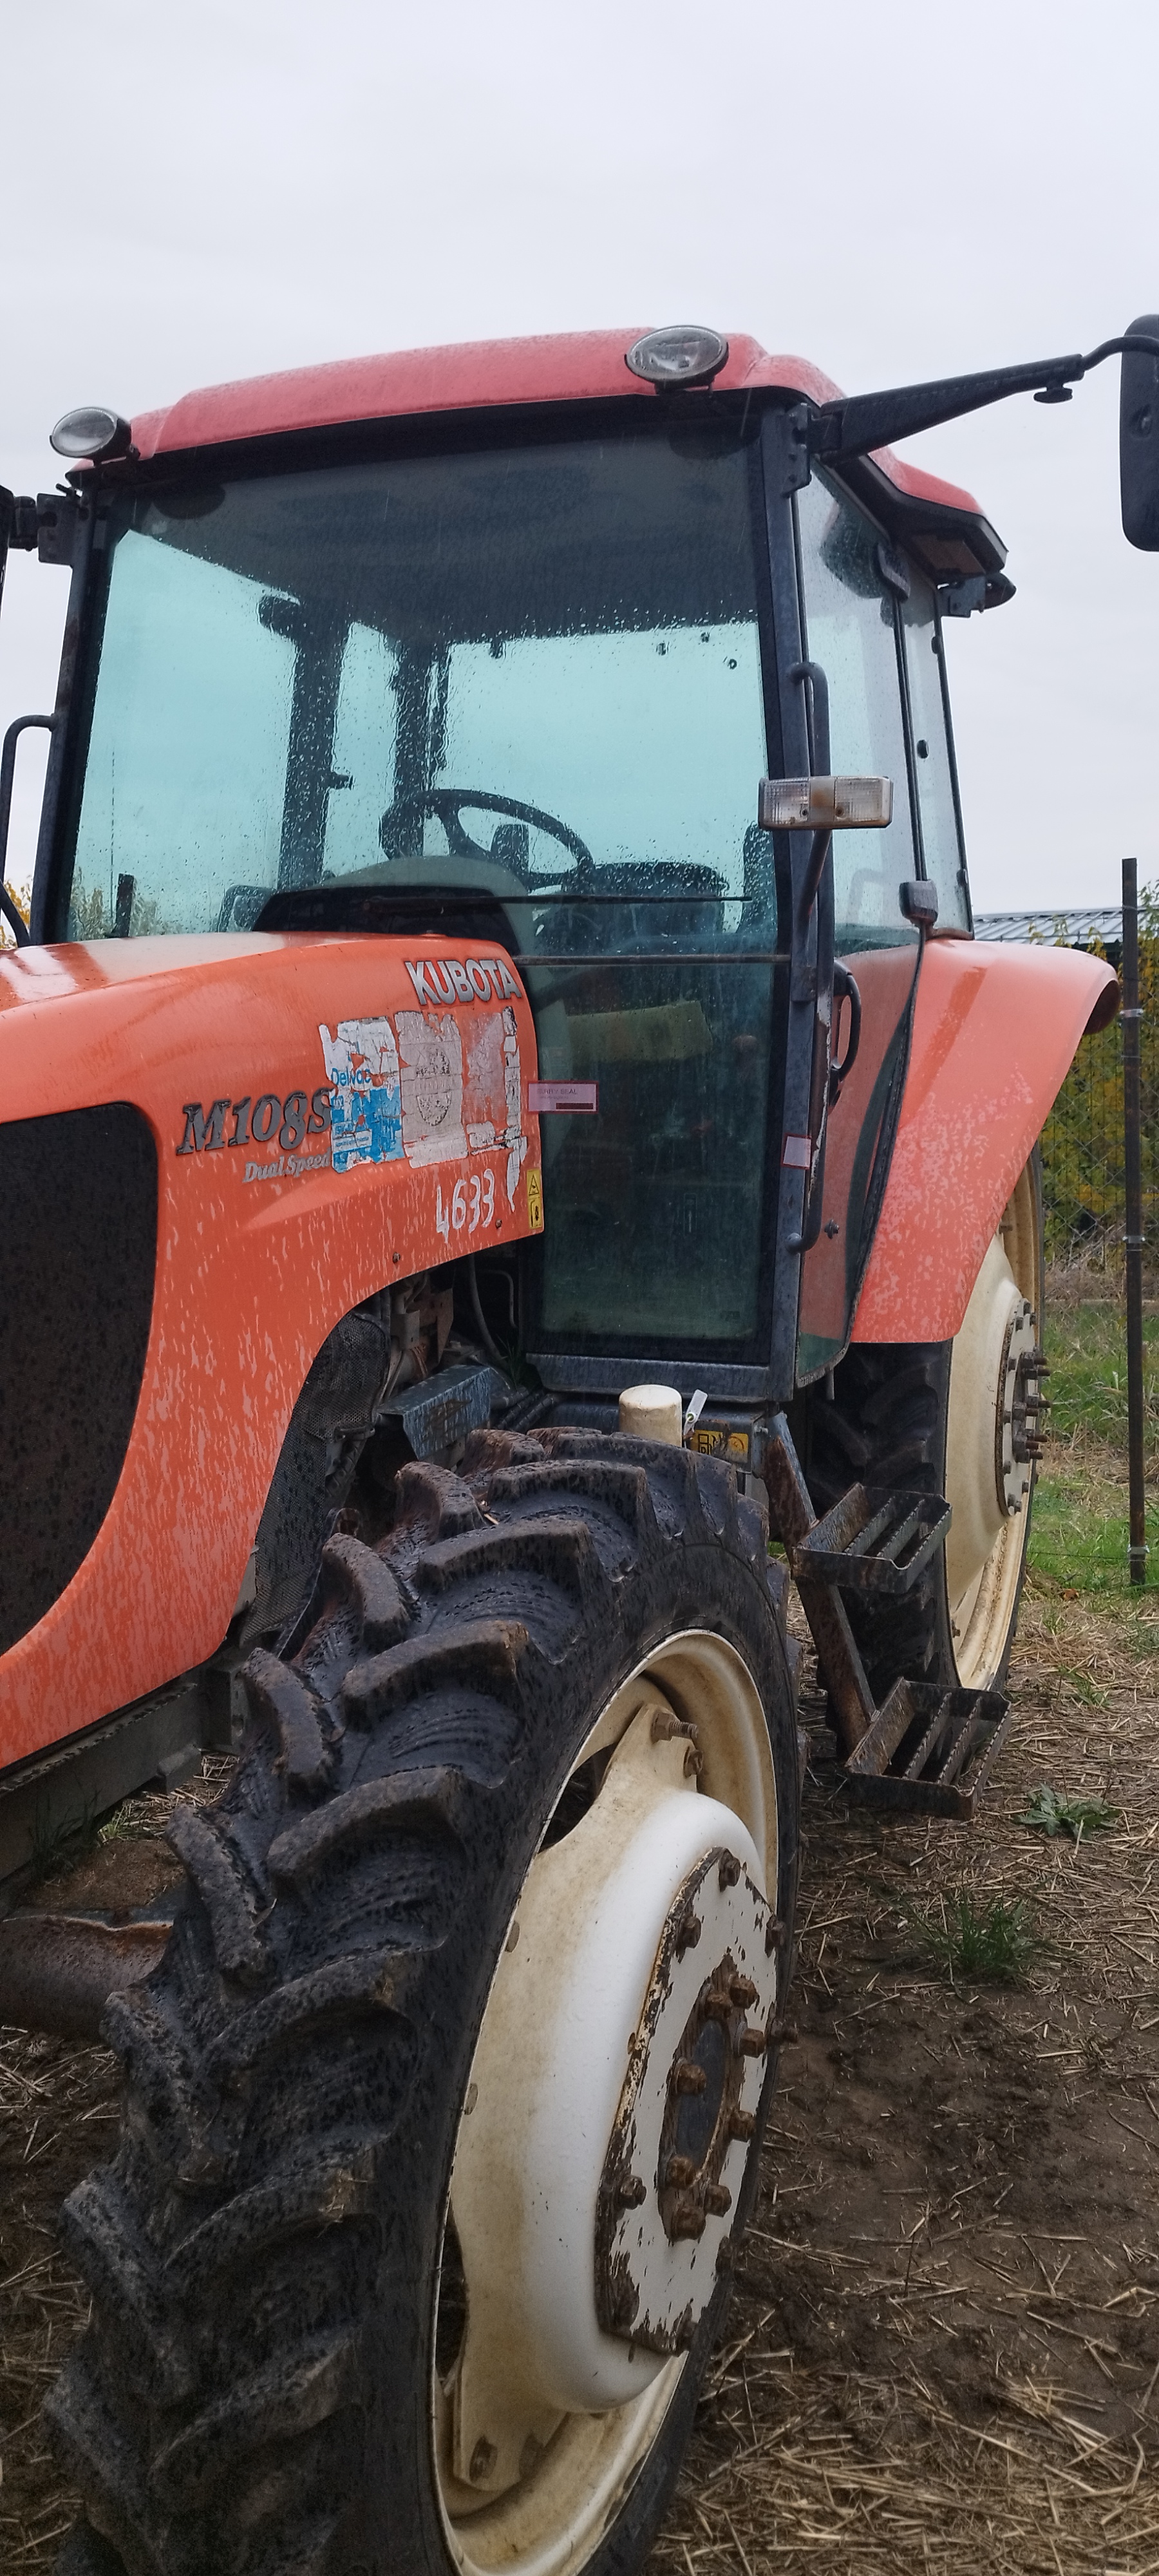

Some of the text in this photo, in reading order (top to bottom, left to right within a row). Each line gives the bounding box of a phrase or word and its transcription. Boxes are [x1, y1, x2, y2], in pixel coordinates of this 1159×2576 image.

[404, 958, 522, 1006] KUBOTA
[176, 1088, 332, 1156] M108S
[242, 1148, 332, 1184] Dual Speed
[436, 1168, 495, 1244] 4633
